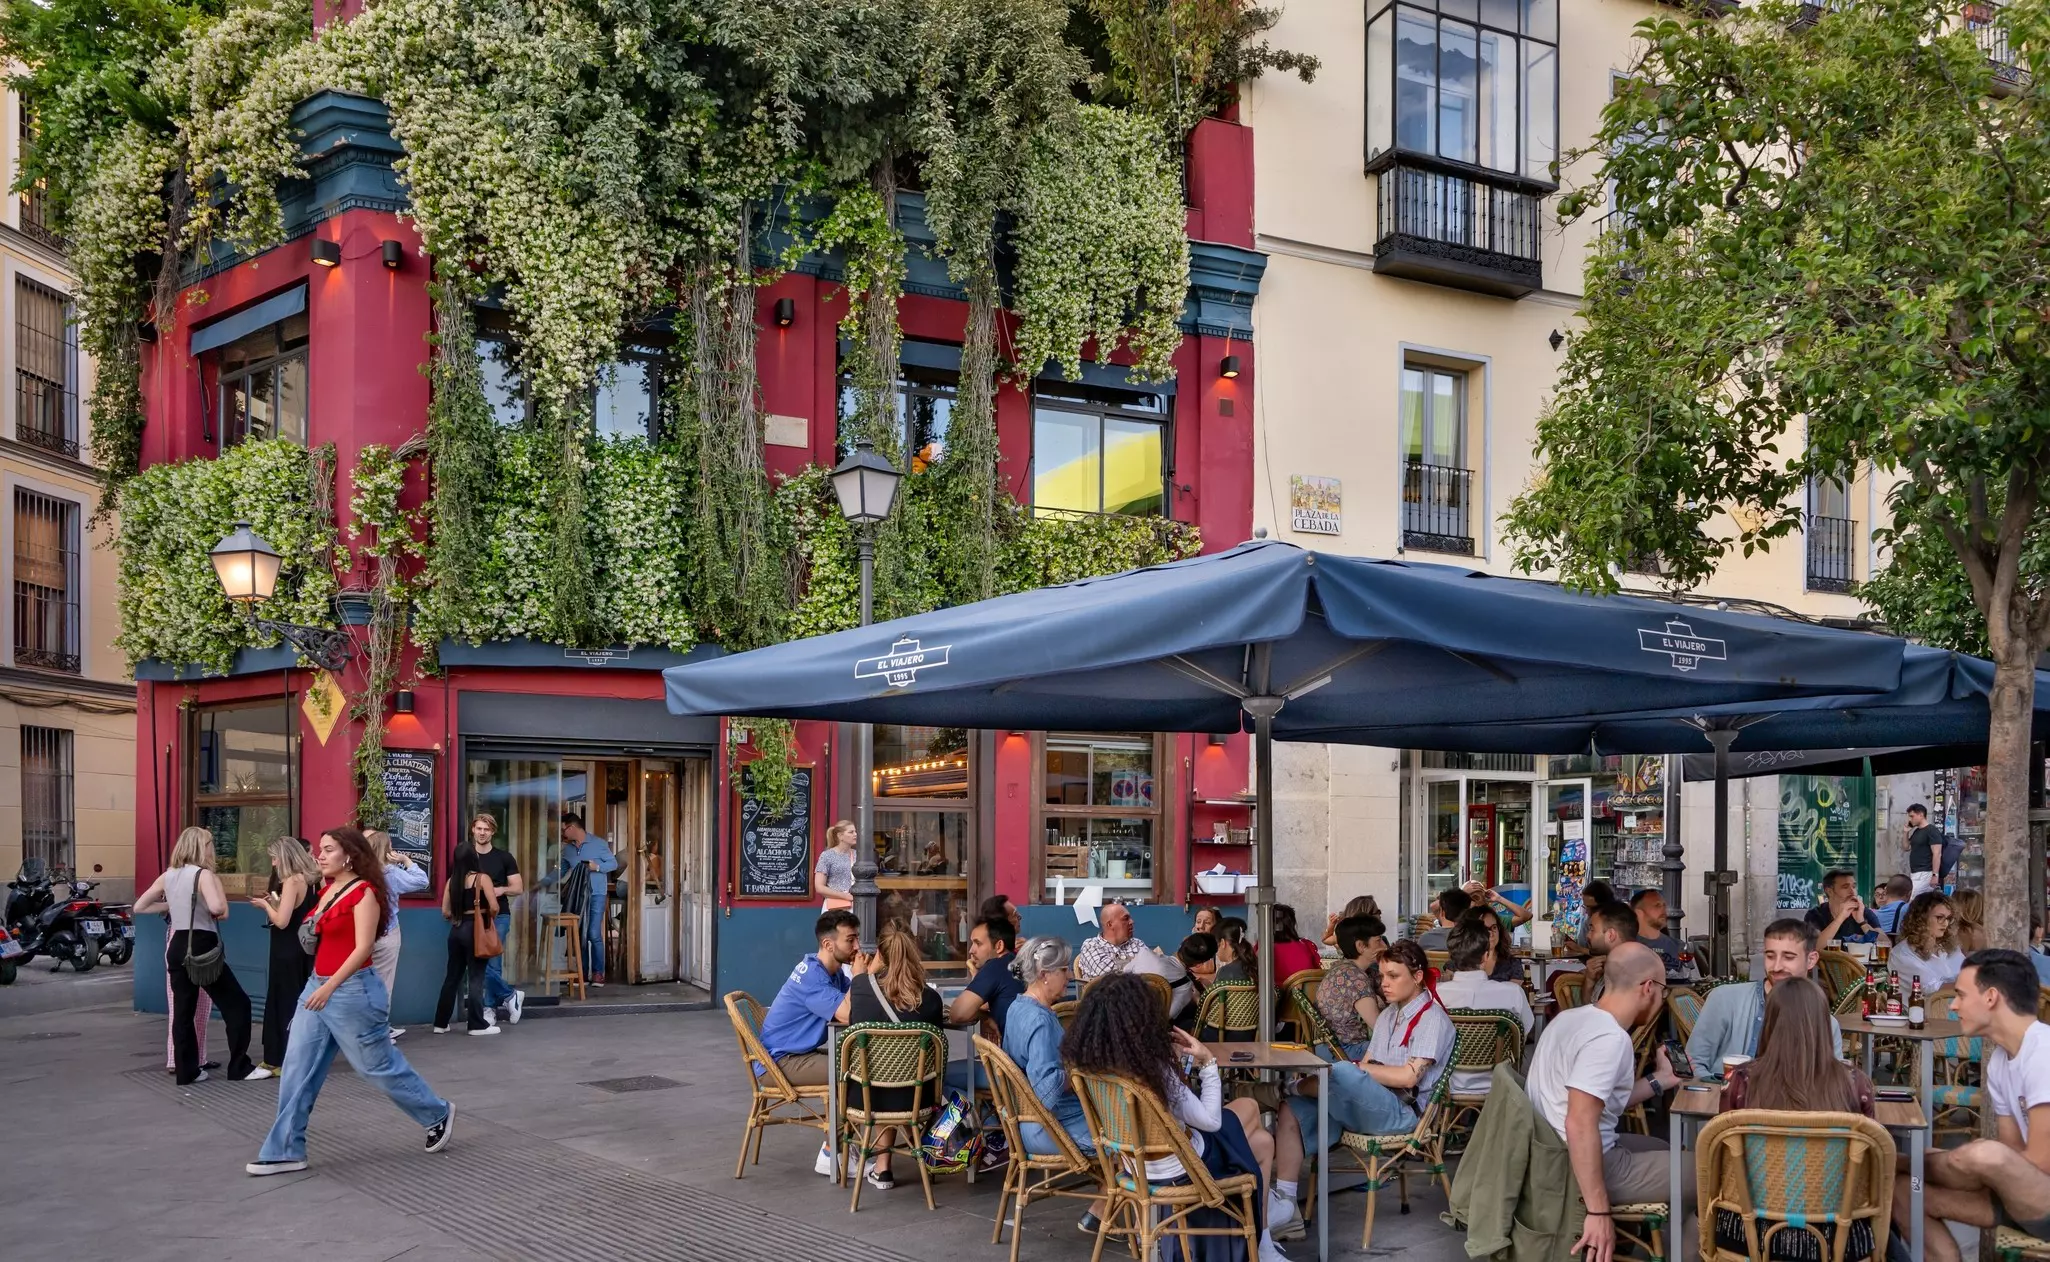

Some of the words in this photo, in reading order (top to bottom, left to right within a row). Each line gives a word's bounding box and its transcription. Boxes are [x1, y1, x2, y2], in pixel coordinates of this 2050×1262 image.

[1295, 509, 1321, 519] PLAZA
[1294, 518, 1339, 532] CEBADA
[1662, 638, 1673, 648] EL
[1674, 640, 1706, 652] VIAJERO
[877, 661, 888, 669] EL
[891, 654, 924, 667] VIAJERO
[1678, 657, 1692, 665] 1995
[893, 672, 909, 681] 1995
[392, 759, 432, 774] CLIMATIZADA
[411, 852, 432, 862] GARDEN
[756, 848, 792, 856] ALCACHOFA
